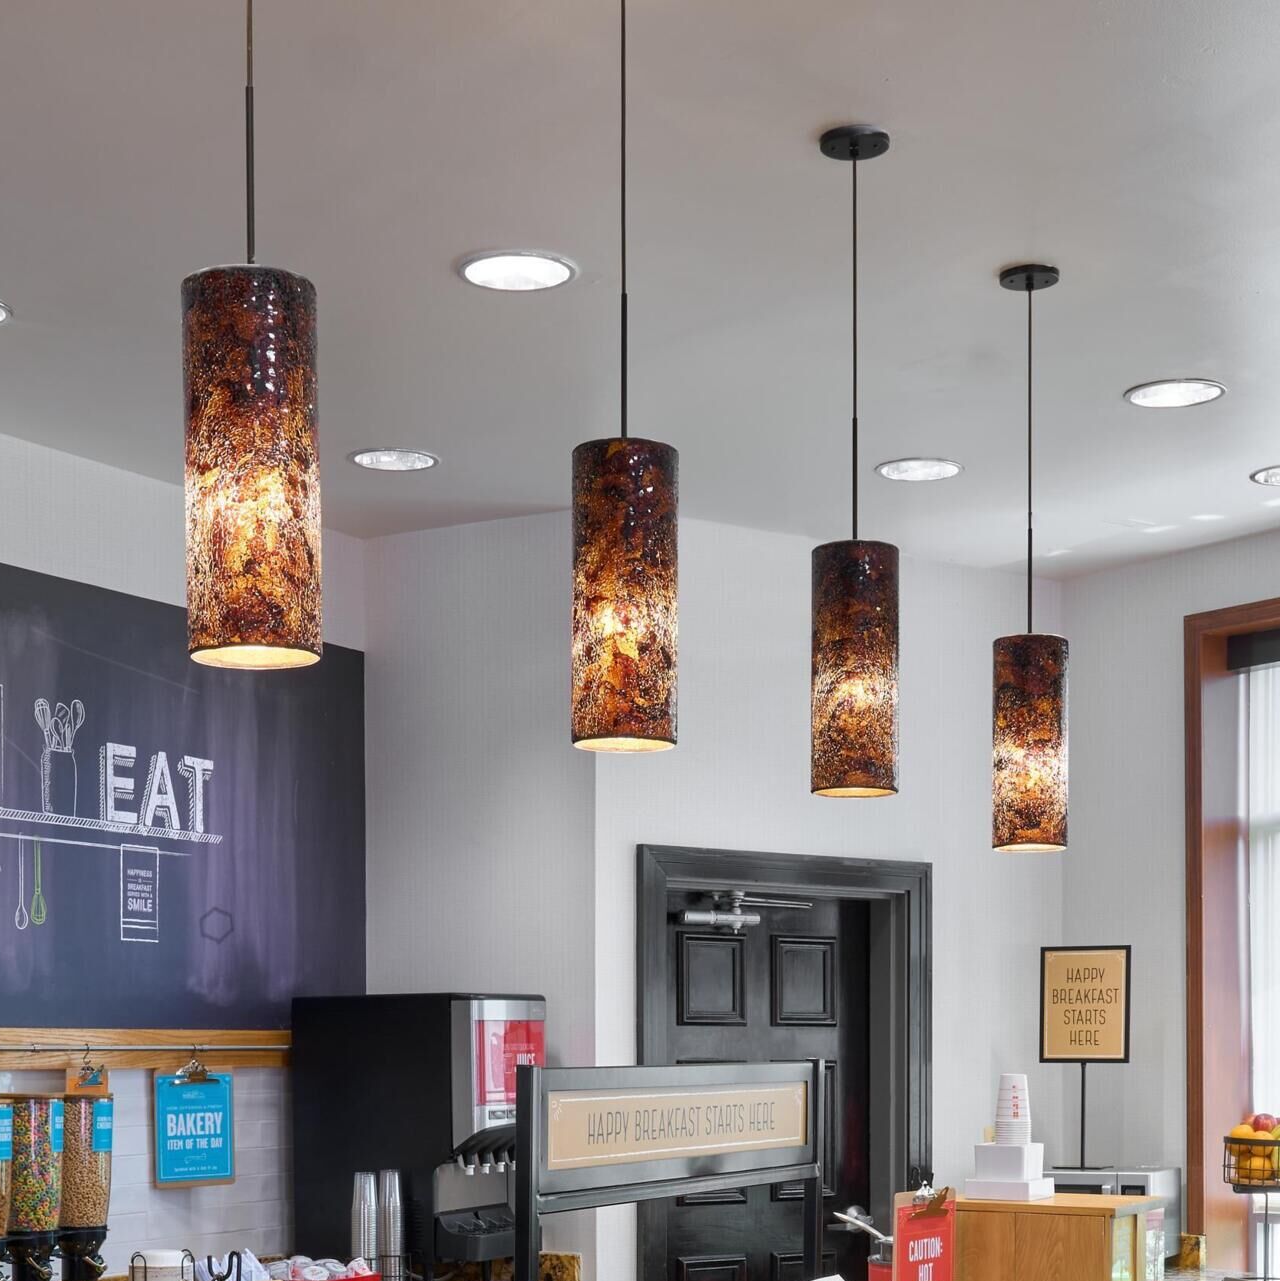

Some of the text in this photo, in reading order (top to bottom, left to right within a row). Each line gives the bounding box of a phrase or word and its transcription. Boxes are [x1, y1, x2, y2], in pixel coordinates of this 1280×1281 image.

[100, 742, 214, 834] EAT
[127, 868, 152, 877] HAPPINESS
[127, 883, 152, 892] BREAKFAST
[127, 897, 153, 912] SMILE
[1066, 967, 1106, 983] HAPPY
[1052, 988, 1120, 1005] BREAKFAST
[1063, 1009, 1106, 1025] STARTS
[1069, 1030, 1100, 1046] HERE
[166, 1112, 223, 1136] BAKERY
[587, 1102, 775, 1145] HAPPY BREAKFAST STARTS HERE
[167, 1137, 223, 1150] ITEM OF THE DAY
[908, 1236, 943, 1262] CAUTION:
